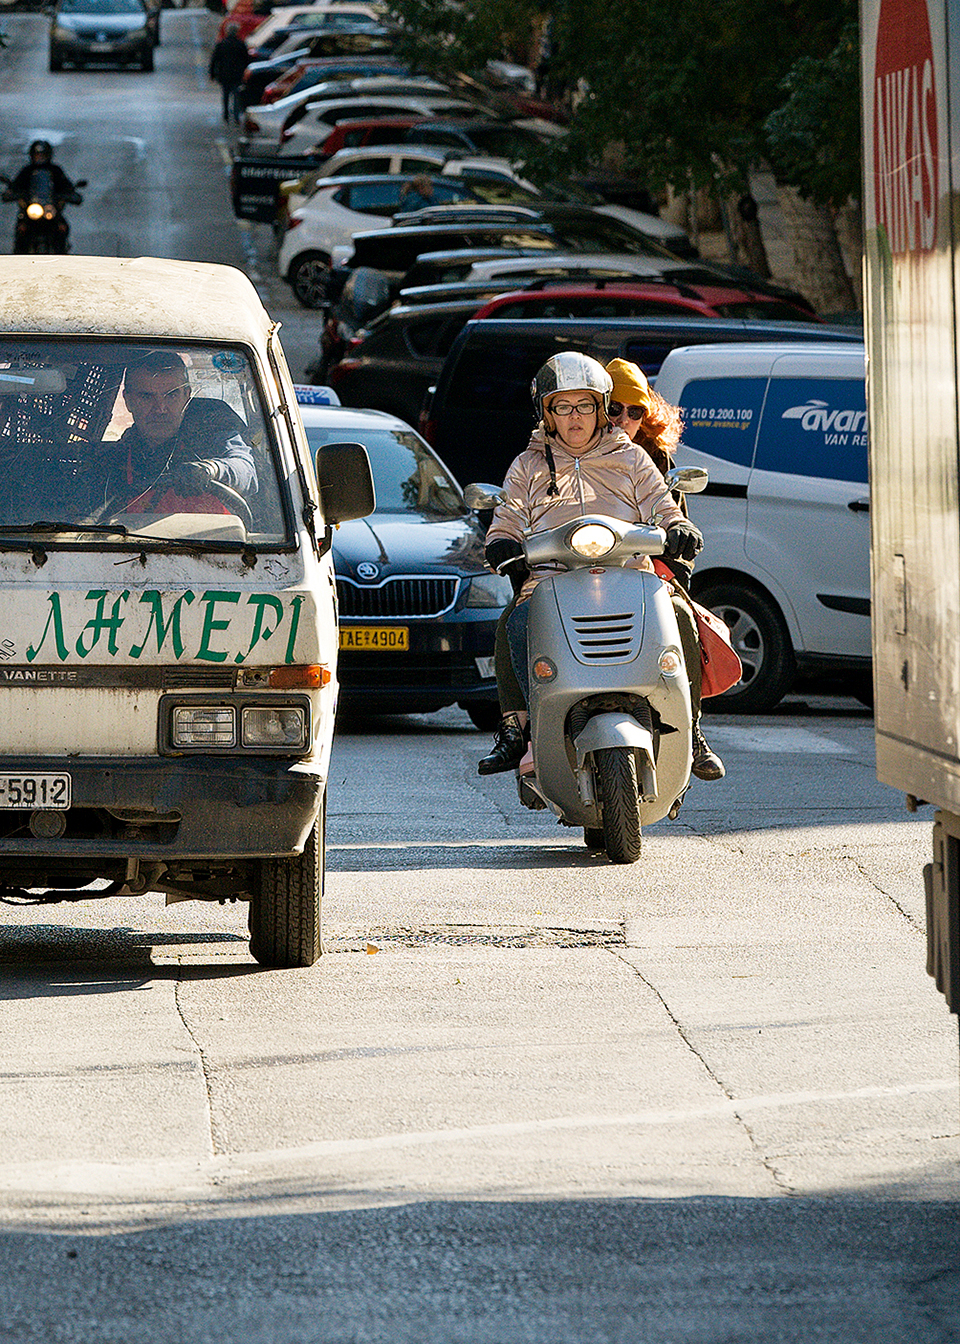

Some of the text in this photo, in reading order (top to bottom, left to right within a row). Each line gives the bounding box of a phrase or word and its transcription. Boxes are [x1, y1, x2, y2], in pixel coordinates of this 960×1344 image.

[877, 59, 936, 254] NIKAS
[690, 408, 708, 419] 210
[709, 408, 753, 421] 9.200.100
[801, 409, 868, 433] avan
[691, 420, 751, 431] www.avance.gr
[824, 433, 868, 447] VAN RE
[3, 670, 78, 682] VANETTE
